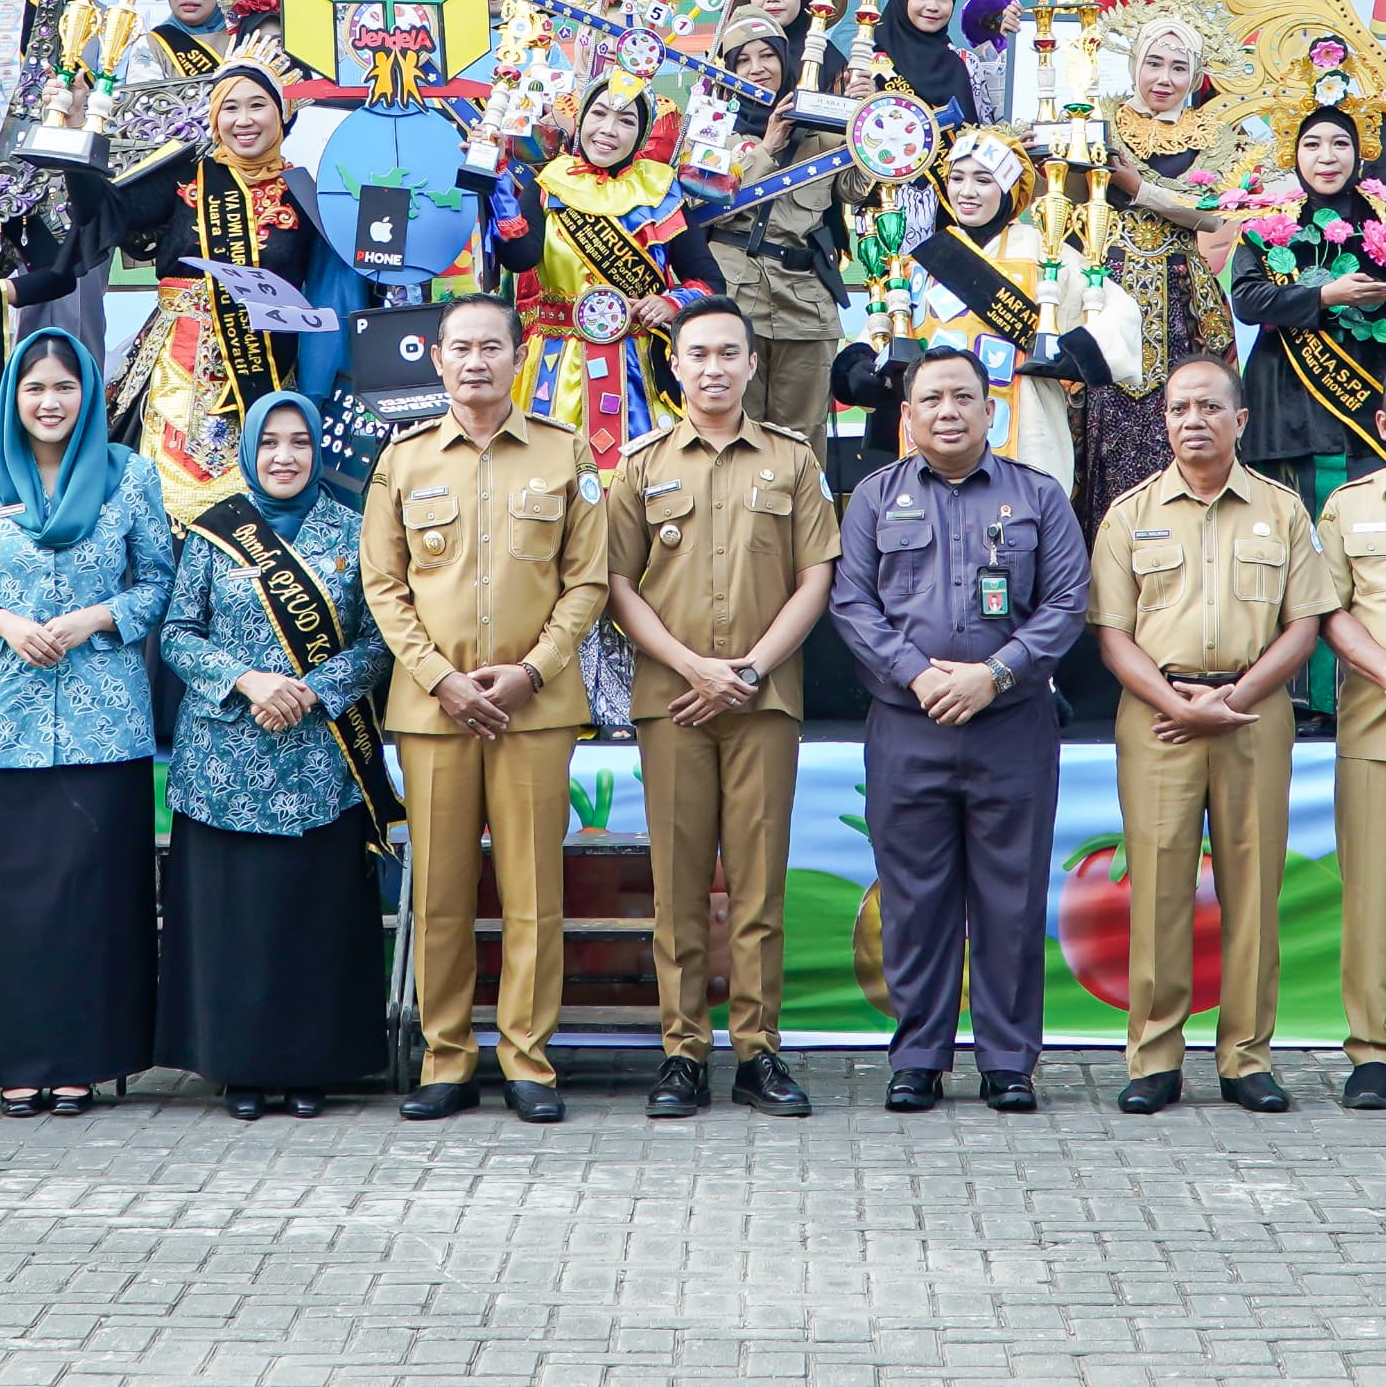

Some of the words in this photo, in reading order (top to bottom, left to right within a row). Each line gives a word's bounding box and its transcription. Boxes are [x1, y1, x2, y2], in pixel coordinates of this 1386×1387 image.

[650, 6, 662, 21] 5
[678, 20, 688, 31] 1
[187, 49, 213, 72] SITI
[982, 144, 999, 161] K
[224, 190, 239, 211] IVA
[208, 195, 222, 236] Juara
[227, 213, 243, 239] DWI
[575, 230, 603, 262] Harapan
[582, 224, 610, 256] Harapan
[356, 250, 403, 266] PHONE
[265, 309, 289, 324] A
[301, 313, 323, 328] C
[991, 302, 1023, 331] Juara
[1026, 330, 1034, 339] 1
[356, 318, 369, 334] P
[986, 310, 1011, 332] Juara
[1011, 332, 1020, 341] 1
[223, 312, 249, 376] Inovatif
[1301, 346, 1323, 376] Guru
[1321, 373, 1364, 412] Inovatif
[333, 389, 342, 402] 1
[342, 394, 354, 409] 2
[355, 400, 366, 414] 3
[322, 416, 334, 430] 7
[342, 410, 353, 425] 4
[353, 416, 364, 430] 5
[334, 422, 345, 436] 8
[365, 421, 376, 435] 6
[320, 434, 332, 448] 9
[331, 440, 343, 453] 0
[232, 522, 278, 574] Bunda
[267, 569, 321, 632] PAUD
